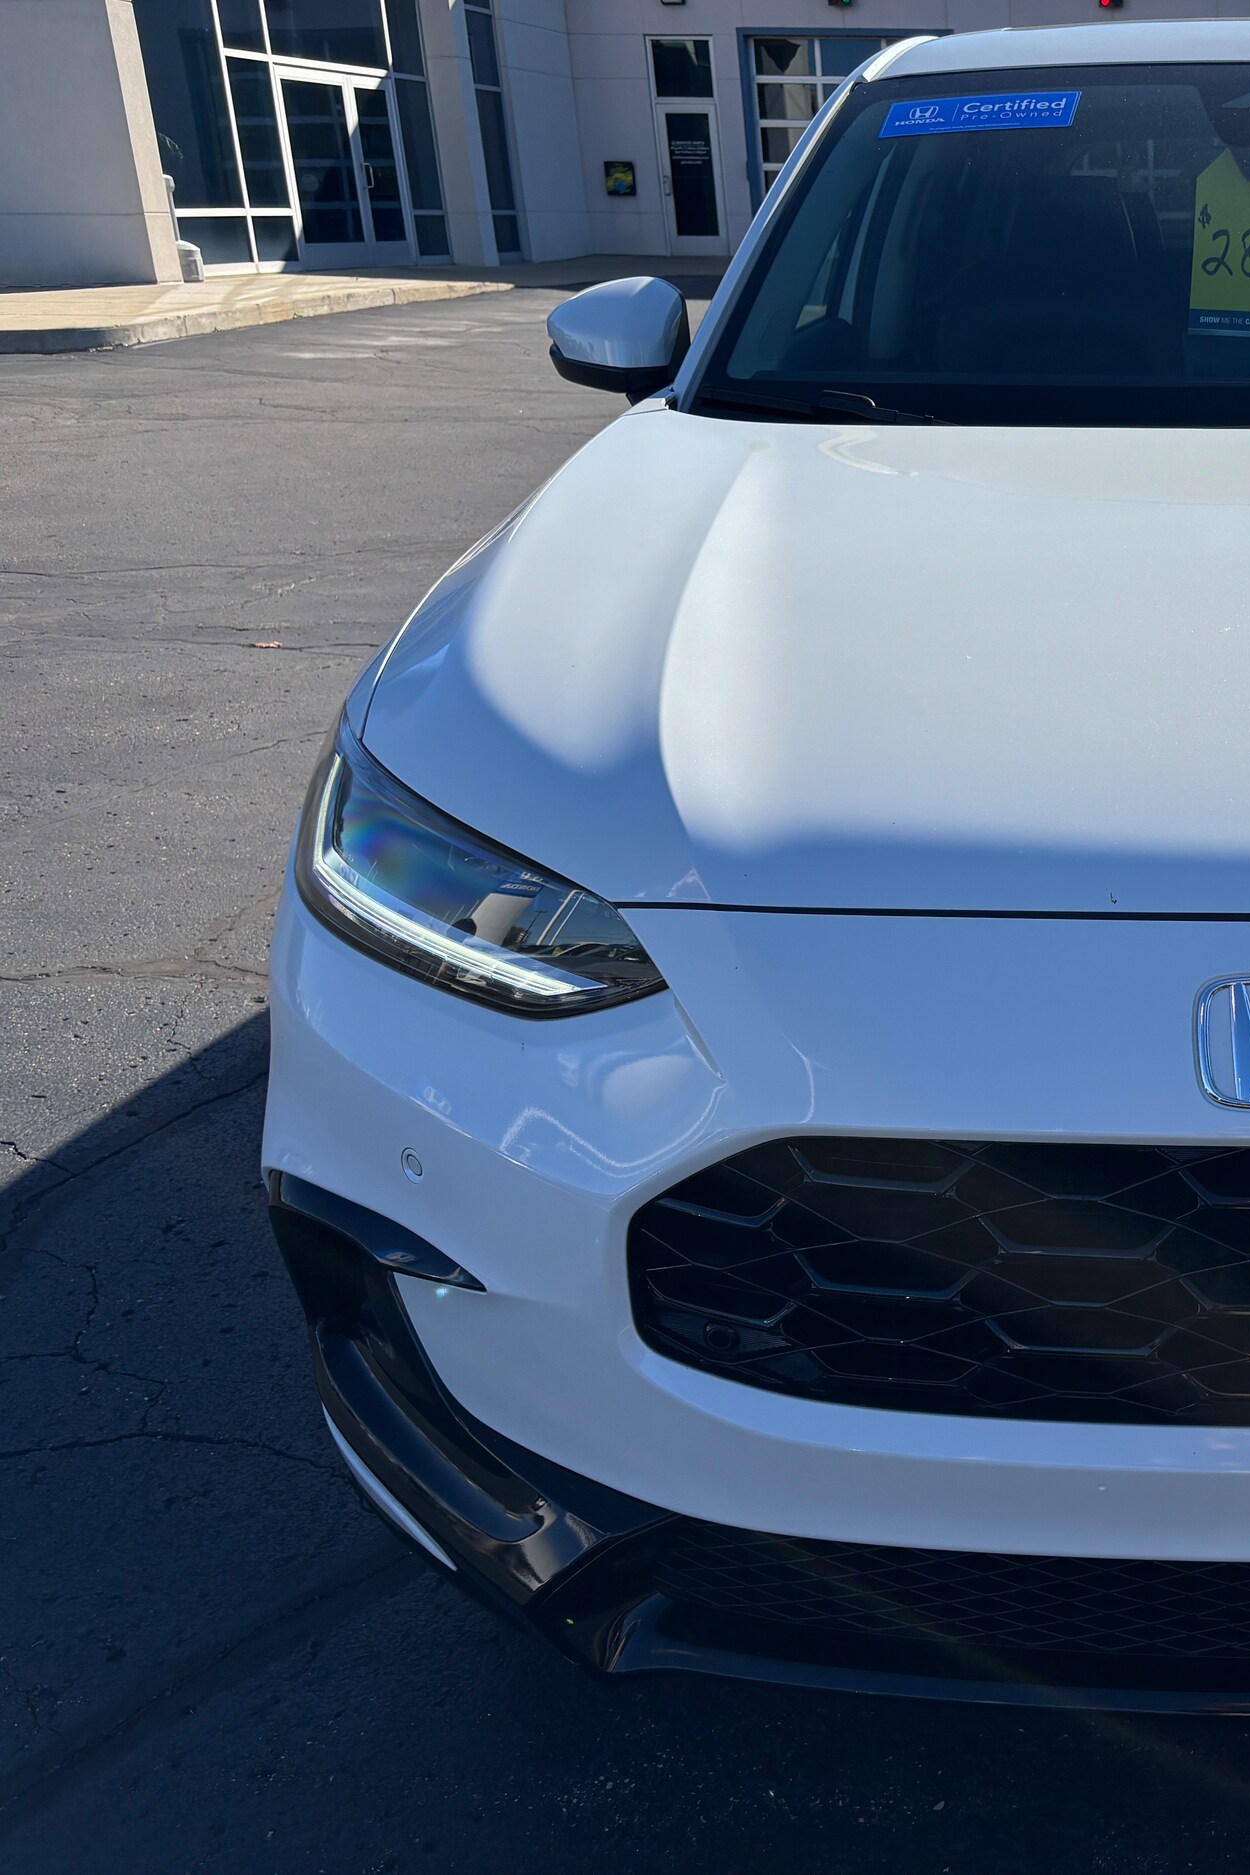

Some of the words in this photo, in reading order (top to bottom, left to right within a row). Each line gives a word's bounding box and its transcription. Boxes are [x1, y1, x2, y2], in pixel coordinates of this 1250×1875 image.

[963, 98, 1067, 113] Certified
[960, 108, 1063, 121] Pre-Owned
[894, 117, 945, 126] HONDA
[1199, 315, 1220, 323] SHOW
[1232, 317, 1244, 325] THE
